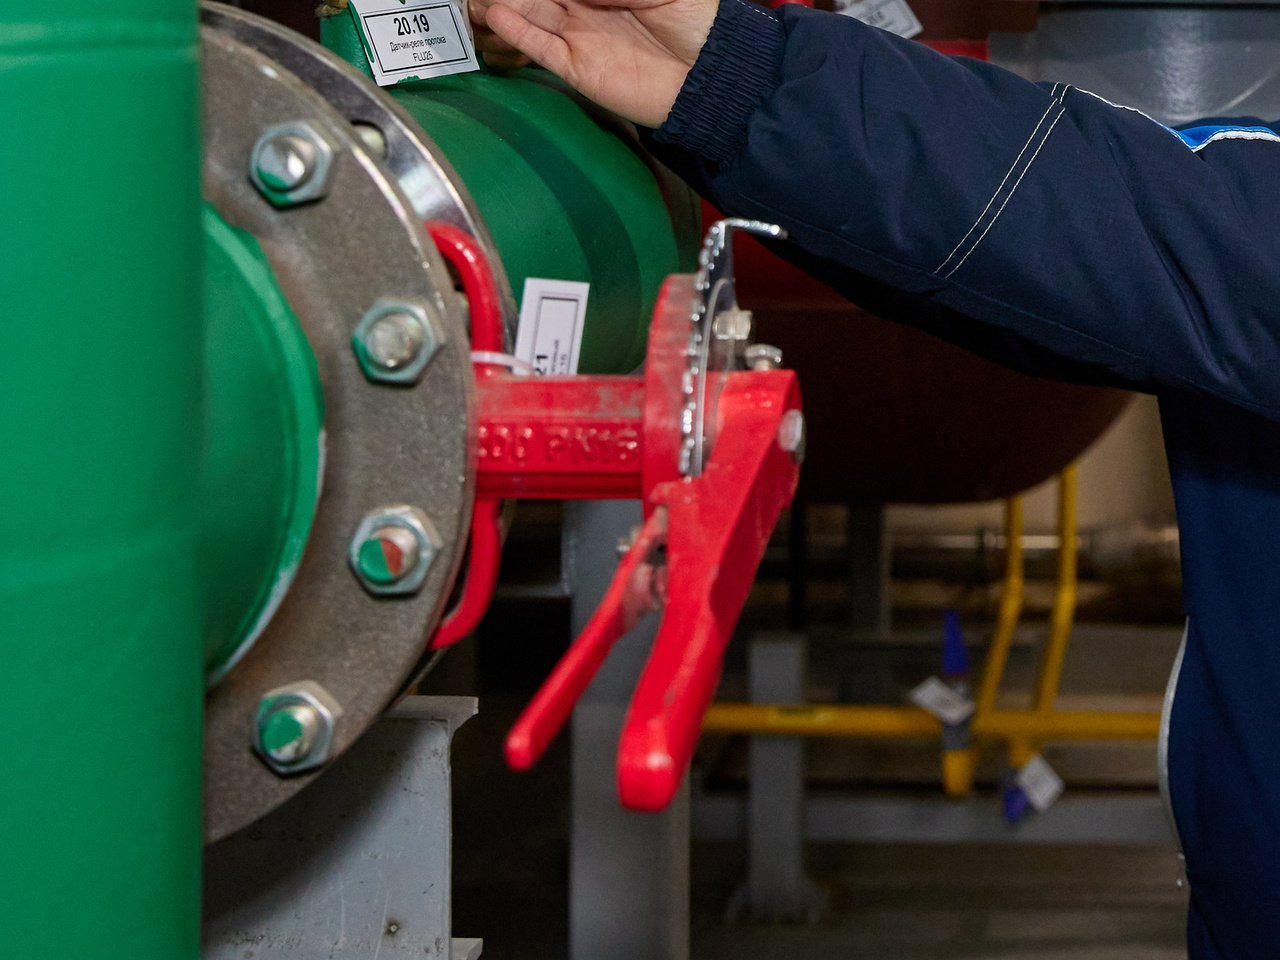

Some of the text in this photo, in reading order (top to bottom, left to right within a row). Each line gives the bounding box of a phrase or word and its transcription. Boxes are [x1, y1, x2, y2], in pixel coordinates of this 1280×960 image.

[393, 13, 430, 36] 20.19
[389, 36, 447, 54] Датчик-реле протока
[412, 50, 434, 62] FLU25
